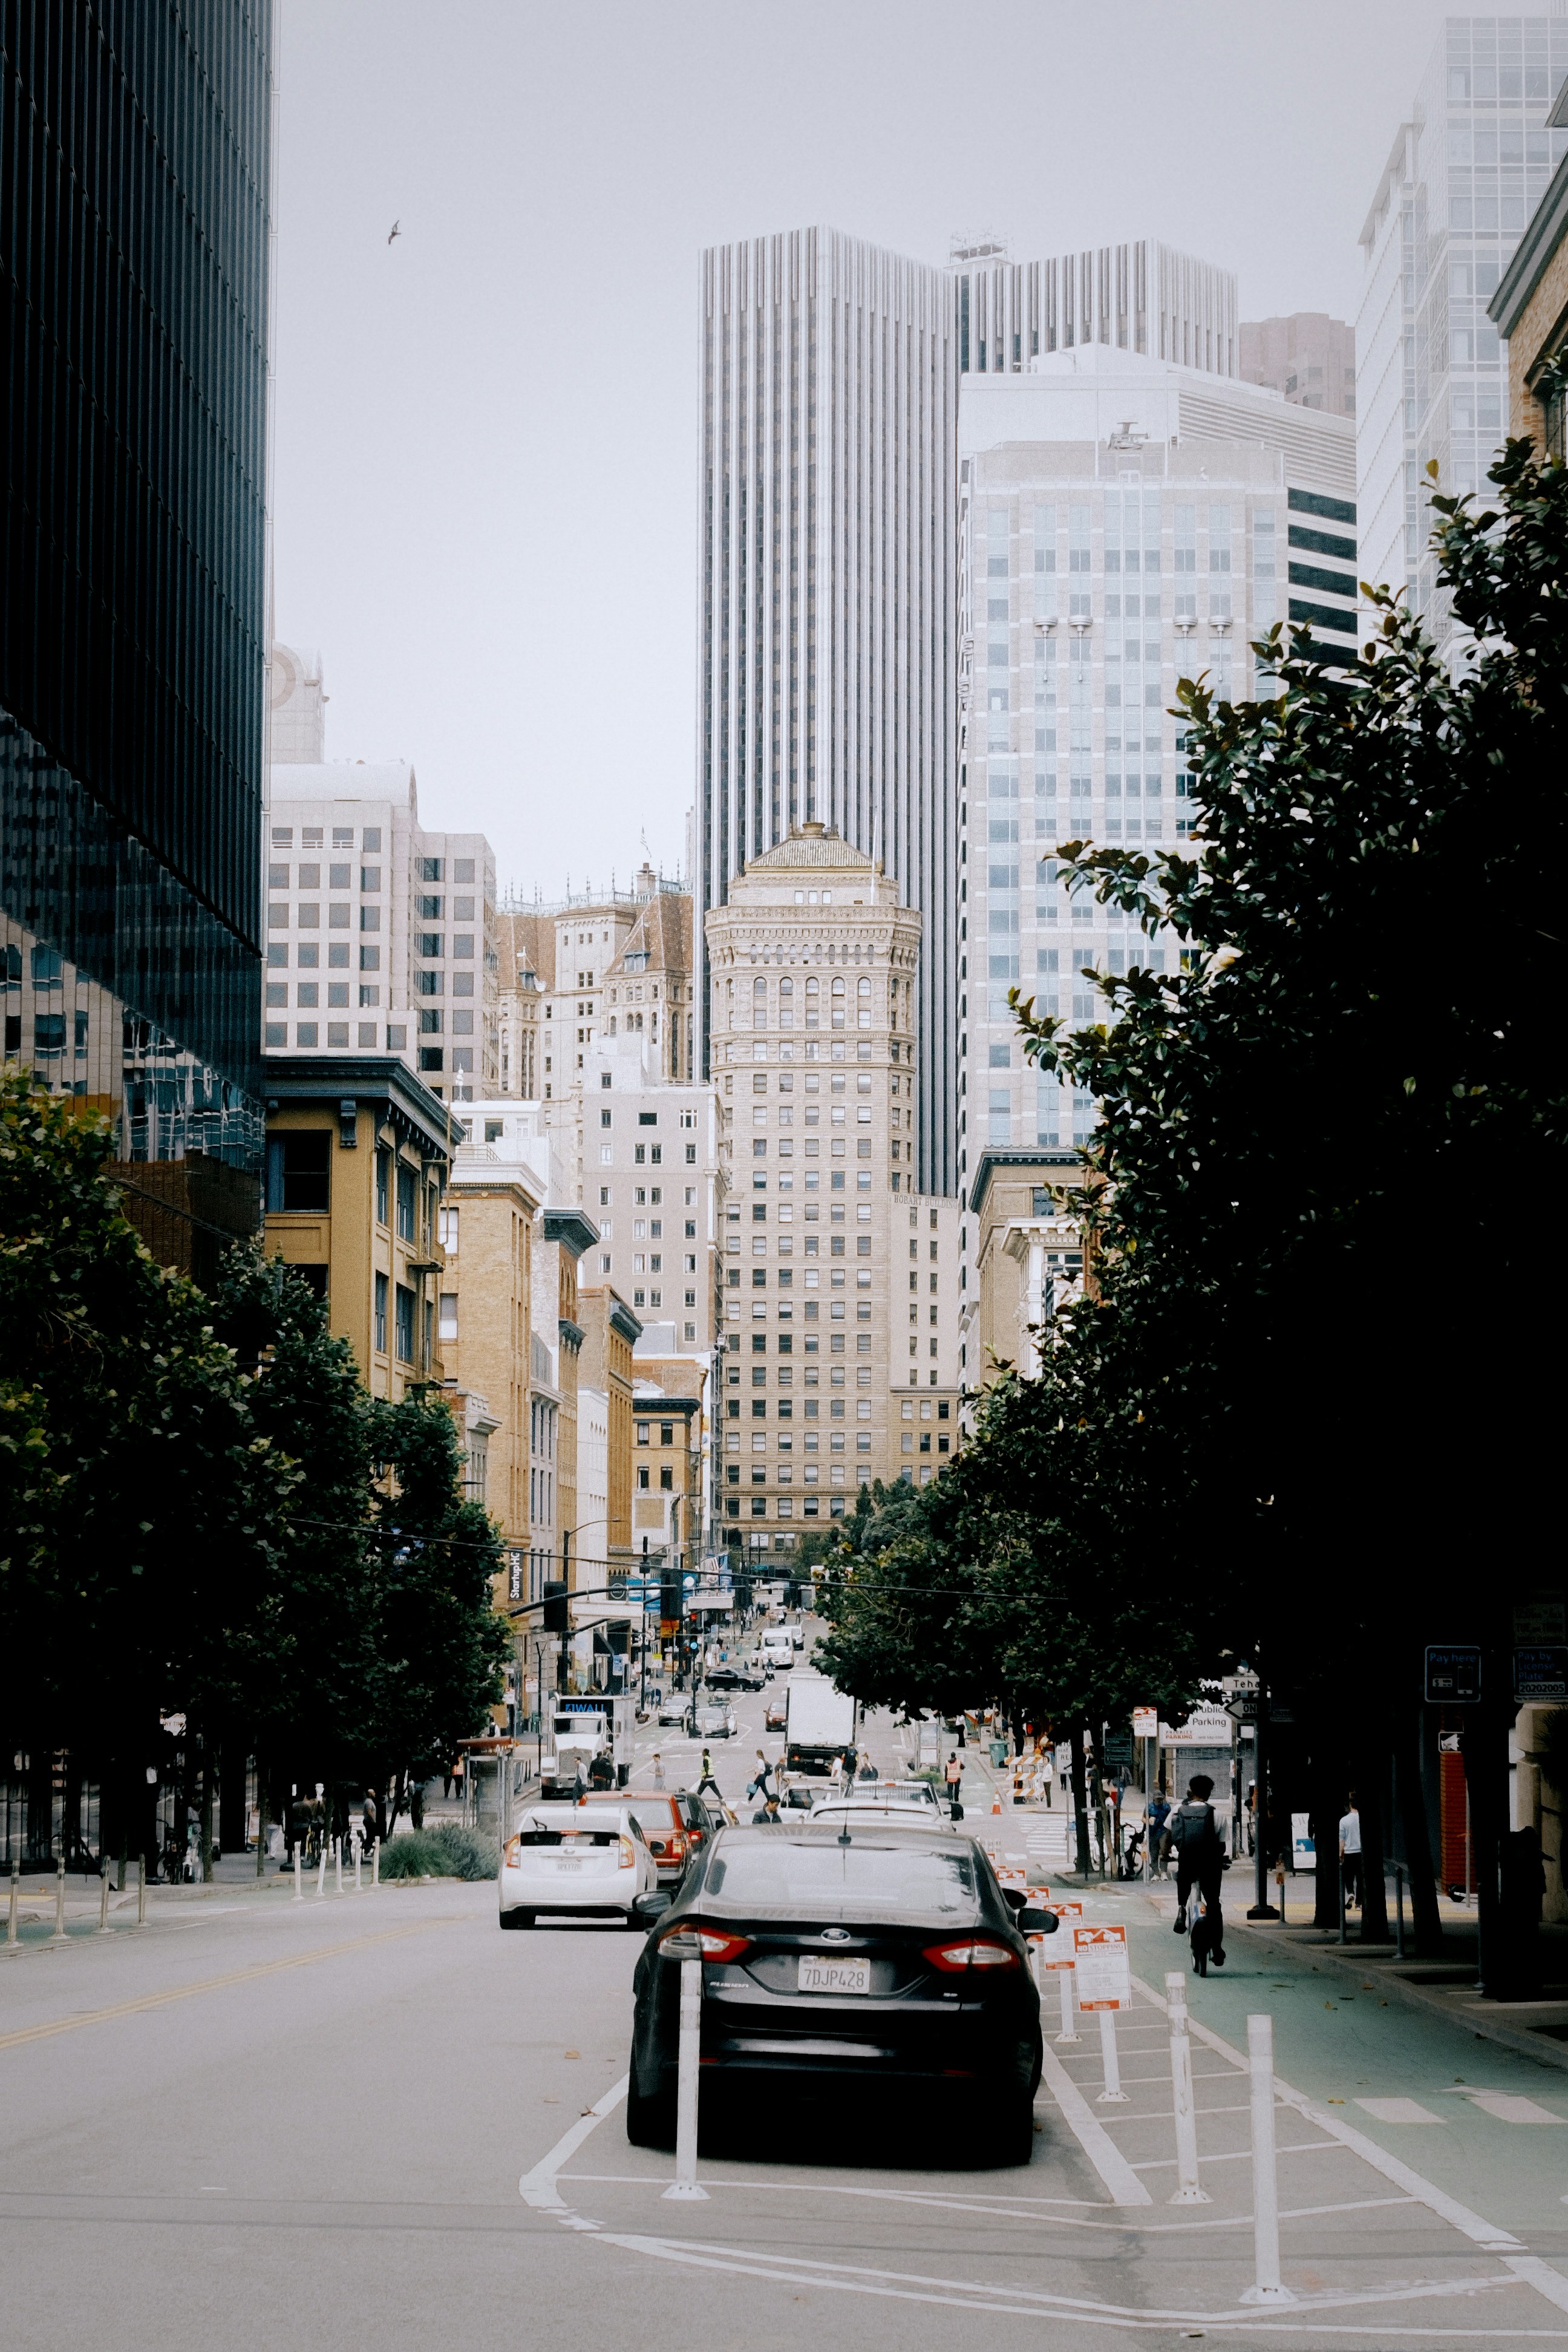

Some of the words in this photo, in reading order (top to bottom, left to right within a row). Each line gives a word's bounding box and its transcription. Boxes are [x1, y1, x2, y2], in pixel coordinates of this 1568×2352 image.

[894, 1195, 922, 1206] HOBART
[925, 1198, 958, 1209] BUILDING
[1429, 1652, 1449, 1665] Pay
[1452, 1651, 1477, 1662] here
[1518, 1651, 1535, 1662] Pay
[1540, 1650, 1552, 1661] by
[1518, 1662, 1555, 1670] License
[1518, 1671, 1544, 1680] Plate
[1520, 1684, 1564, 1693] 20202005
[1243, 1704, 1258, 1713] ON
[1192, 1717, 1226, 1727] Parking
[1089, 1942, 1123, 1951] STOPPING
[804, 1969, 864, 1987] 7DJP428
